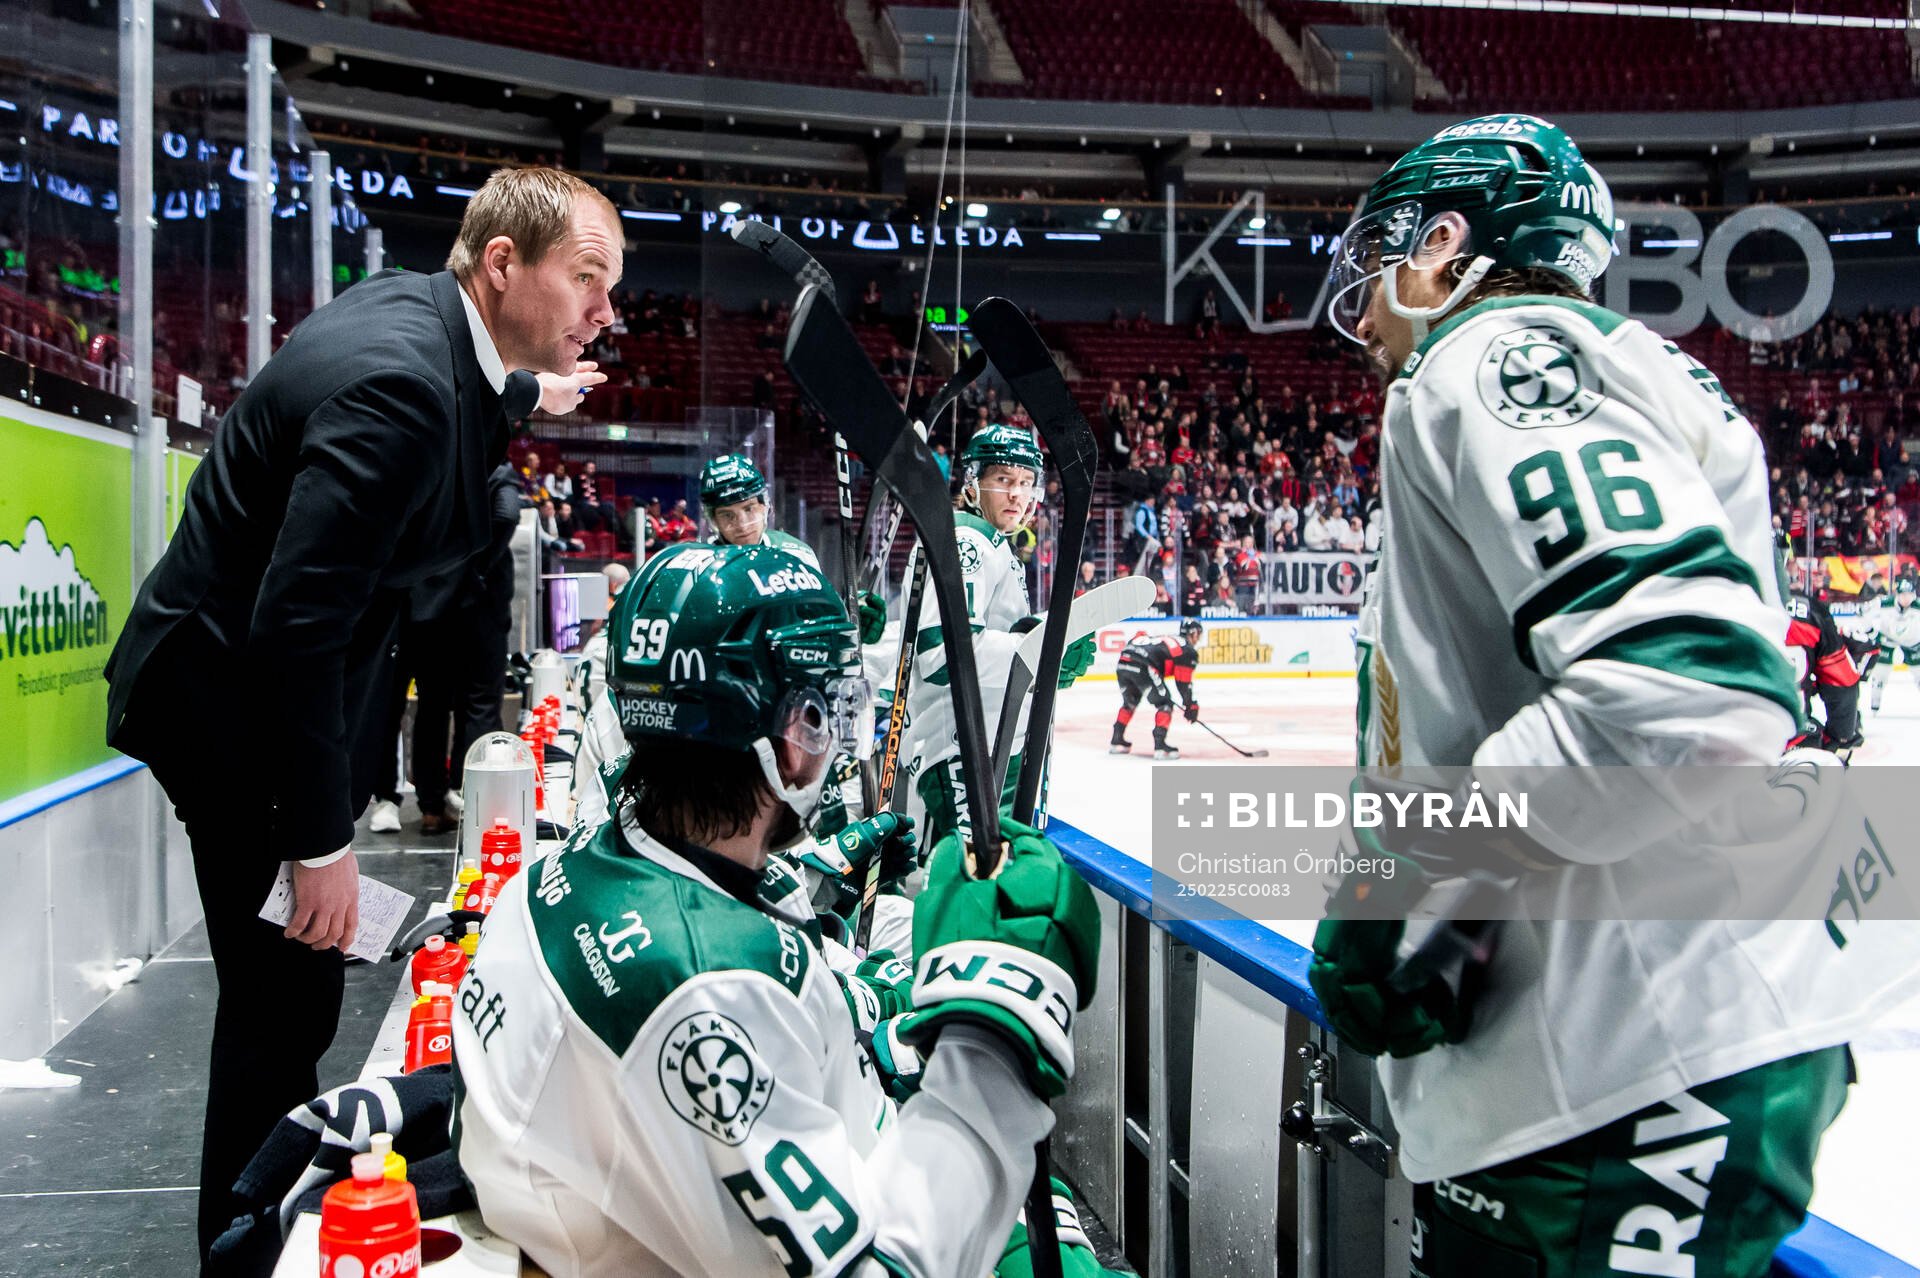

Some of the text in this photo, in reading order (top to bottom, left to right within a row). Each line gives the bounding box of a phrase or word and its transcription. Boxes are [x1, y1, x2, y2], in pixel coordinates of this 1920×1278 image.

[43, 104, 120, 146] PAR
[1431, 172, 1490, 189] CCM
[911, 224, 1024, 247] ELEDA
[1508, 439, 1664, 571] 96
[0, 583, 107, 660] vättbilen
[627, 619, 669, 660] 59
[790, 648, 829, 662] CCM
[621, 699, 678, 718] HOCKEY
[881, 699, 907, 789] TACKS
[922, 955, 1071, 1036] CCM
[666, 1019, 738, 1071] FLÄK
[693, 1077, 769, 1140] TEKNIK
[721, 1139, 859, 1278] 59
[1433, 1178, 1505, 1220] CCM
